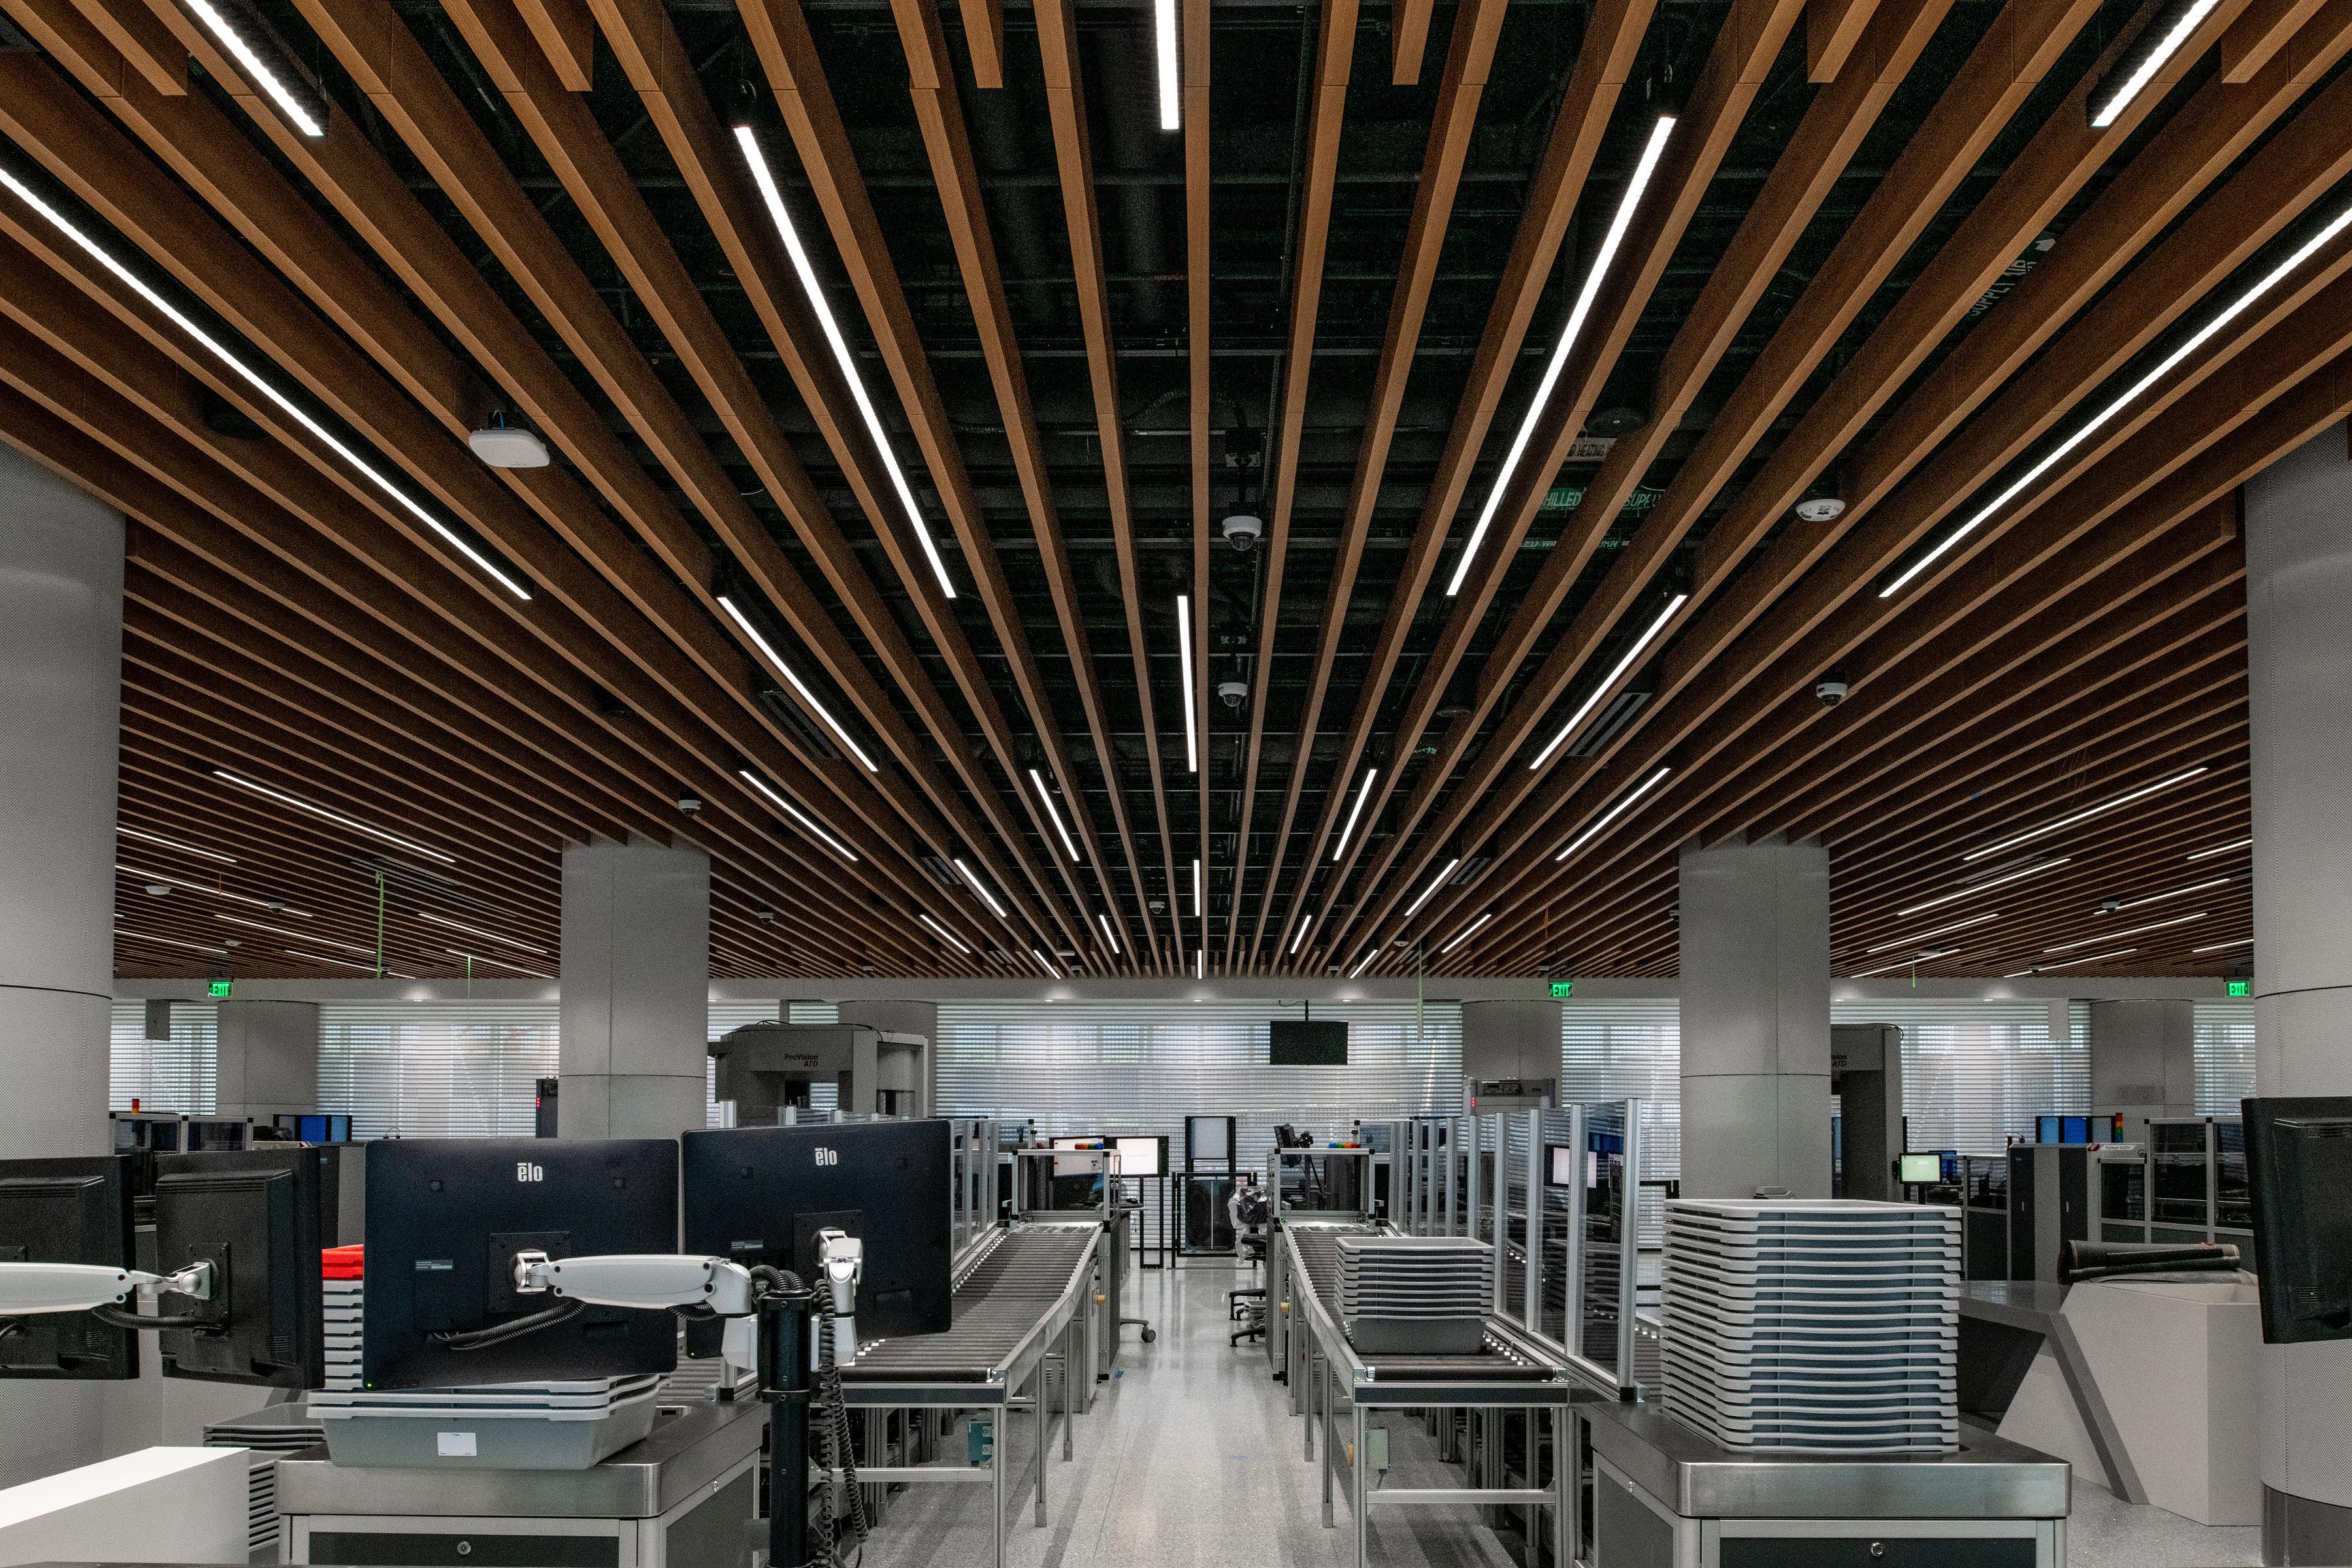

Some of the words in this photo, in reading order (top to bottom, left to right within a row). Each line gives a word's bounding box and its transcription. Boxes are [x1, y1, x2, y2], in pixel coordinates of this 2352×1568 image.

[1542, 492, 1582, 506] HILLED
[212, 983, 230, 996] EXIT
[1552, 984, 1570, 997] EXIT
[2229, 983, 2246, 996] EXIT
